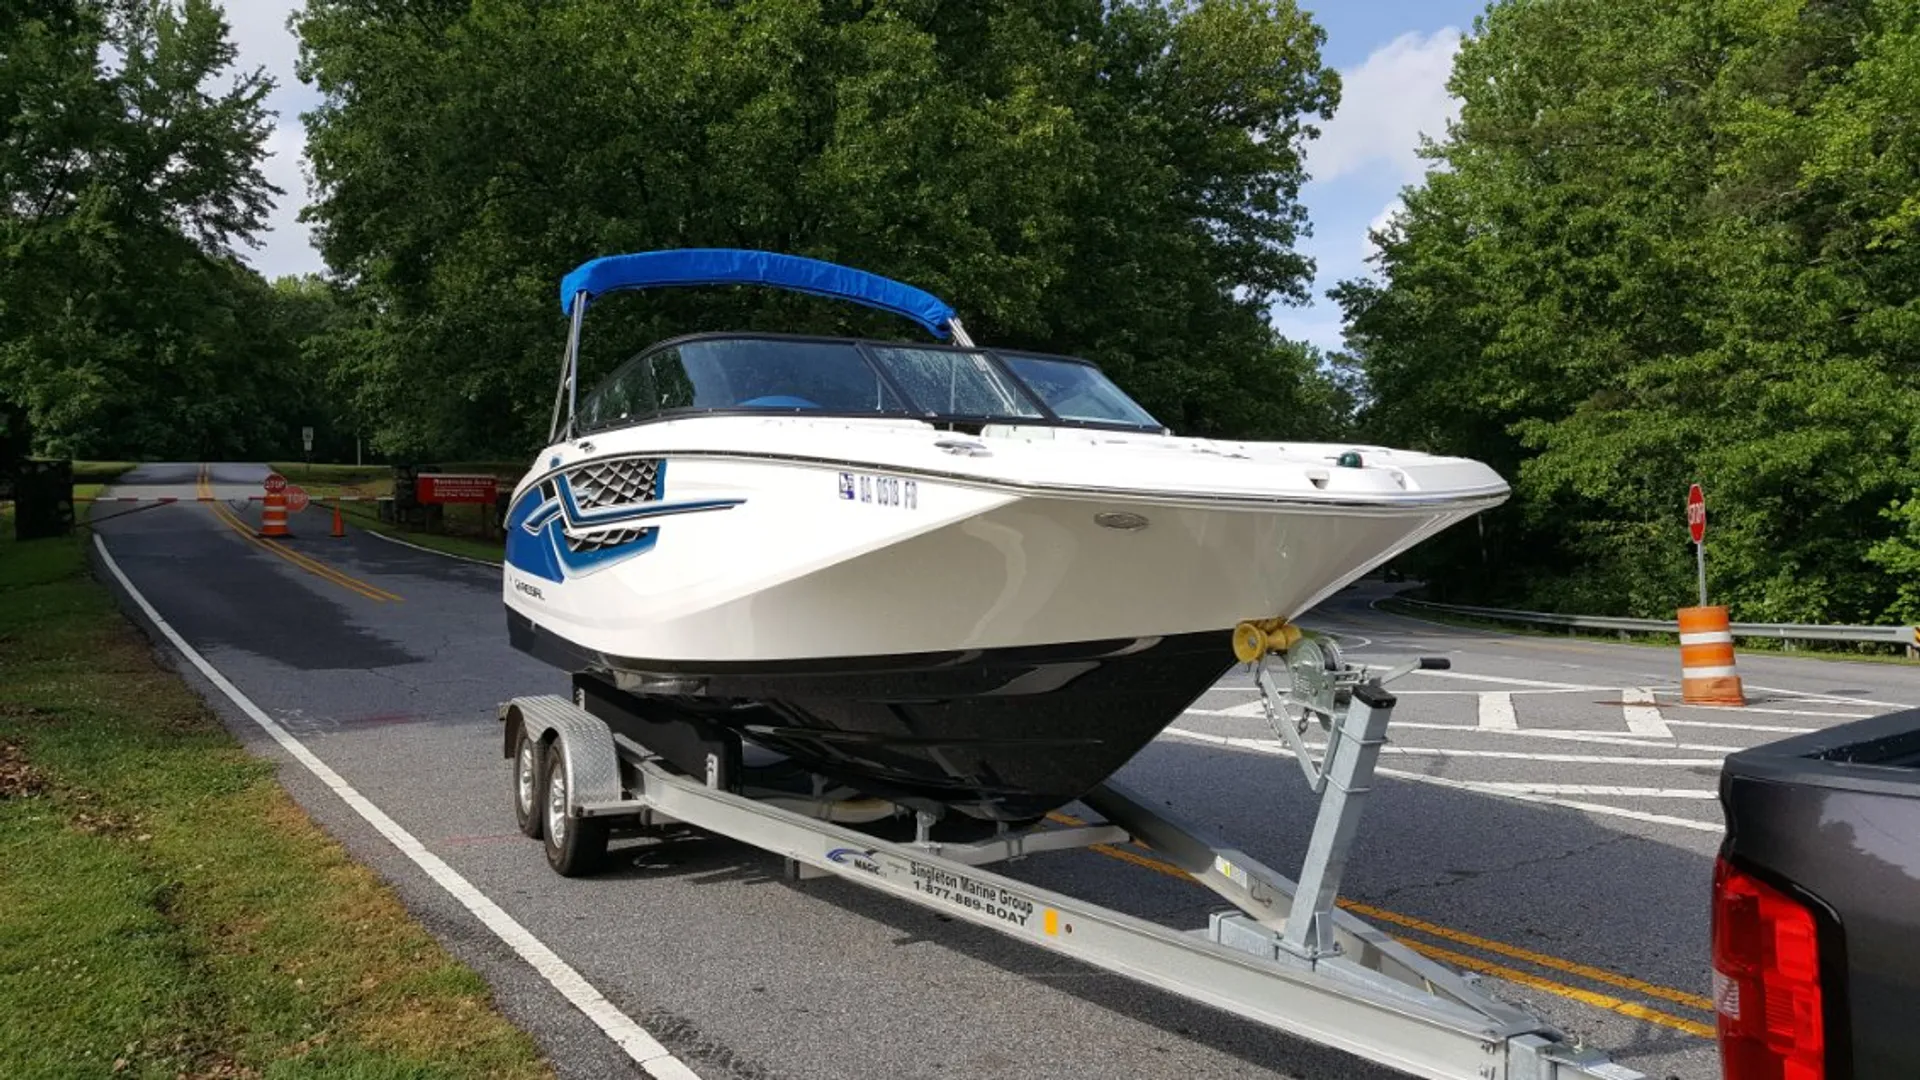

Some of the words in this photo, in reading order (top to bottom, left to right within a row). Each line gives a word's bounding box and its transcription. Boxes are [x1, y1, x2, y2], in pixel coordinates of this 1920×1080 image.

[266, 480, 285, 489] STOP
[1689, 503, 1705, 525] STOP
[854, 859, 880, 875] MAGIC
[910, 861, 957, 889] Singleton
[960, 876, 996, 901] Marine
[999, 889, 1033, 915] Group
[913, 880, 1027, 926] 1-877-889-BOAT
